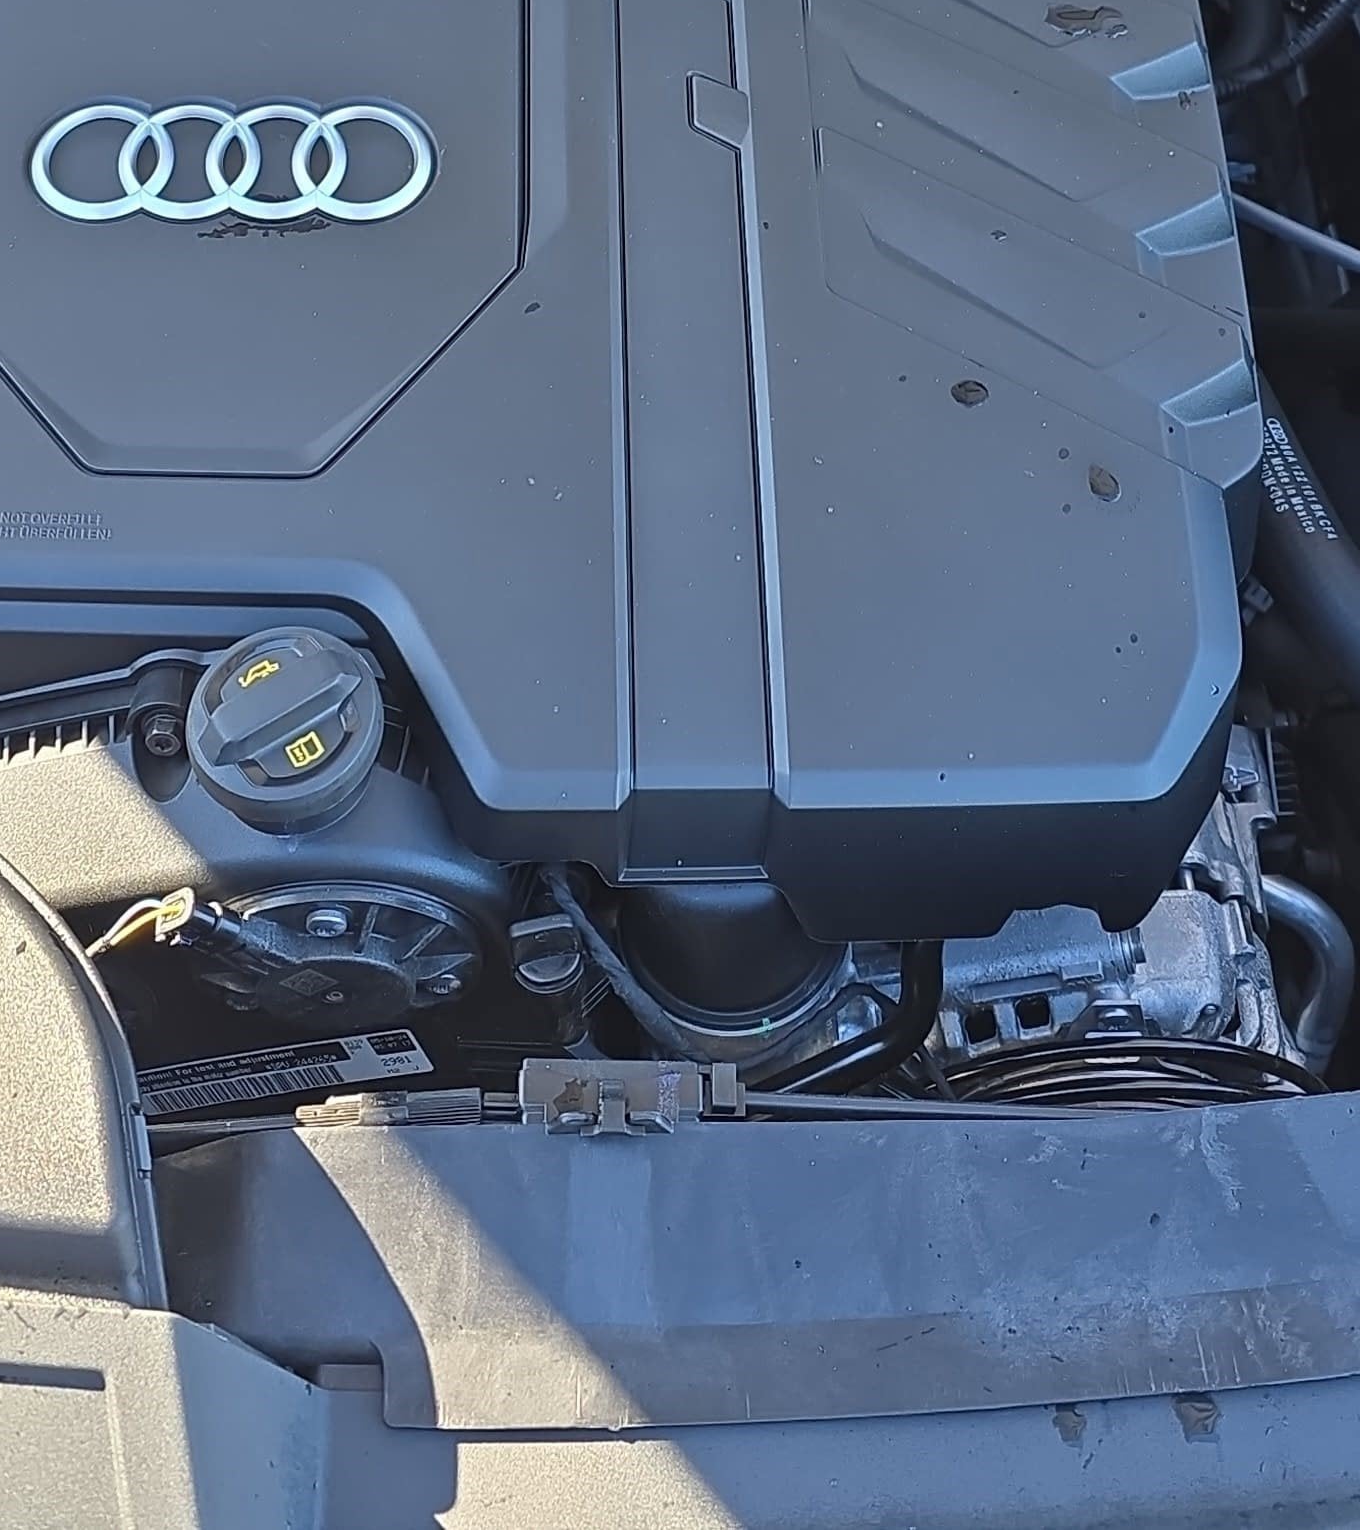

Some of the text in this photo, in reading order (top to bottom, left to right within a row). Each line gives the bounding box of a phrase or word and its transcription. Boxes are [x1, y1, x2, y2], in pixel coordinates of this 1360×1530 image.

[1270, 457, 1291, 484] Made
[1290, 496, 1315, 533] Mexico
[0, 512, 31, 525] NOT
